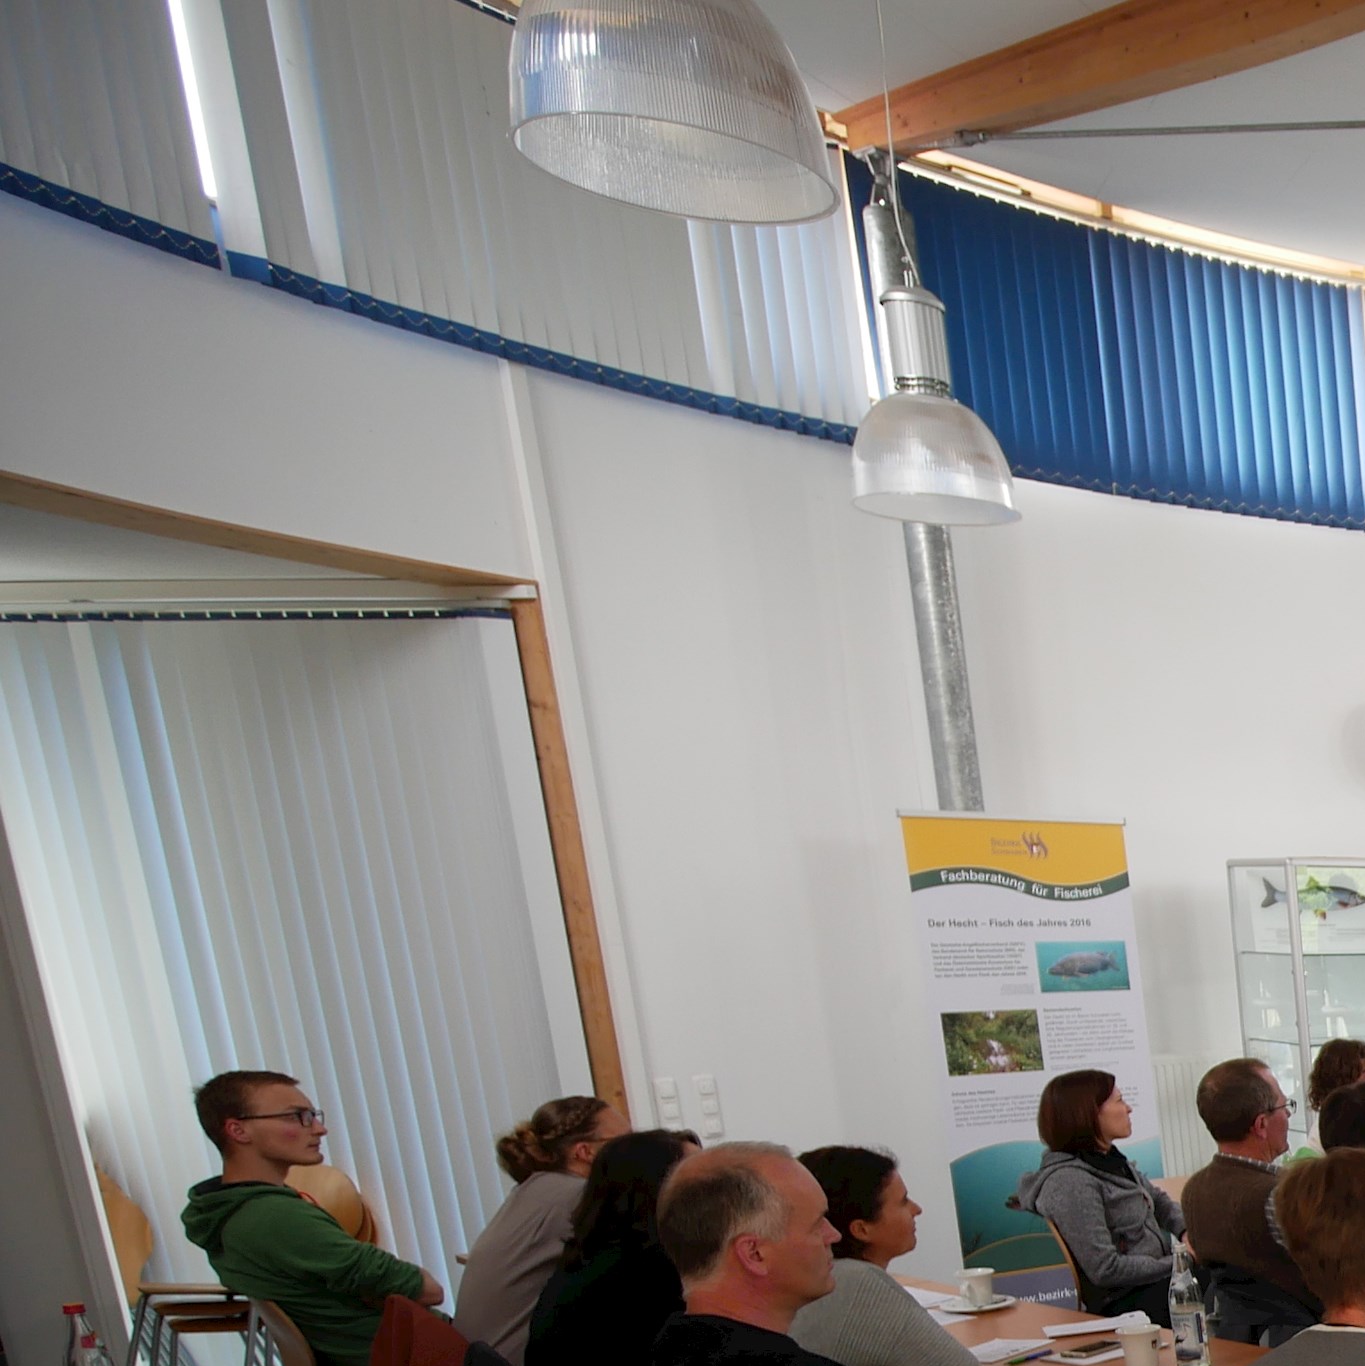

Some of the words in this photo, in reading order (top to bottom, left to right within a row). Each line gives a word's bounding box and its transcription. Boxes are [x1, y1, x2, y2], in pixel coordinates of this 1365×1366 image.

[940, 870, 1026, 892] Fachberatung
[1031, 883, 1049, 896] für
[1054, 884, 1103, 899] Fischerei
[927, 919, 945, 928] Der
[948, 919, 978, 928] Hecht
[989, 919, 1014, 927] Fisch
[1017, 919, 1034, 927] des
[1036, 918, 1068, 927] Jahres
[1069, 918, 1091, 927] 2016
